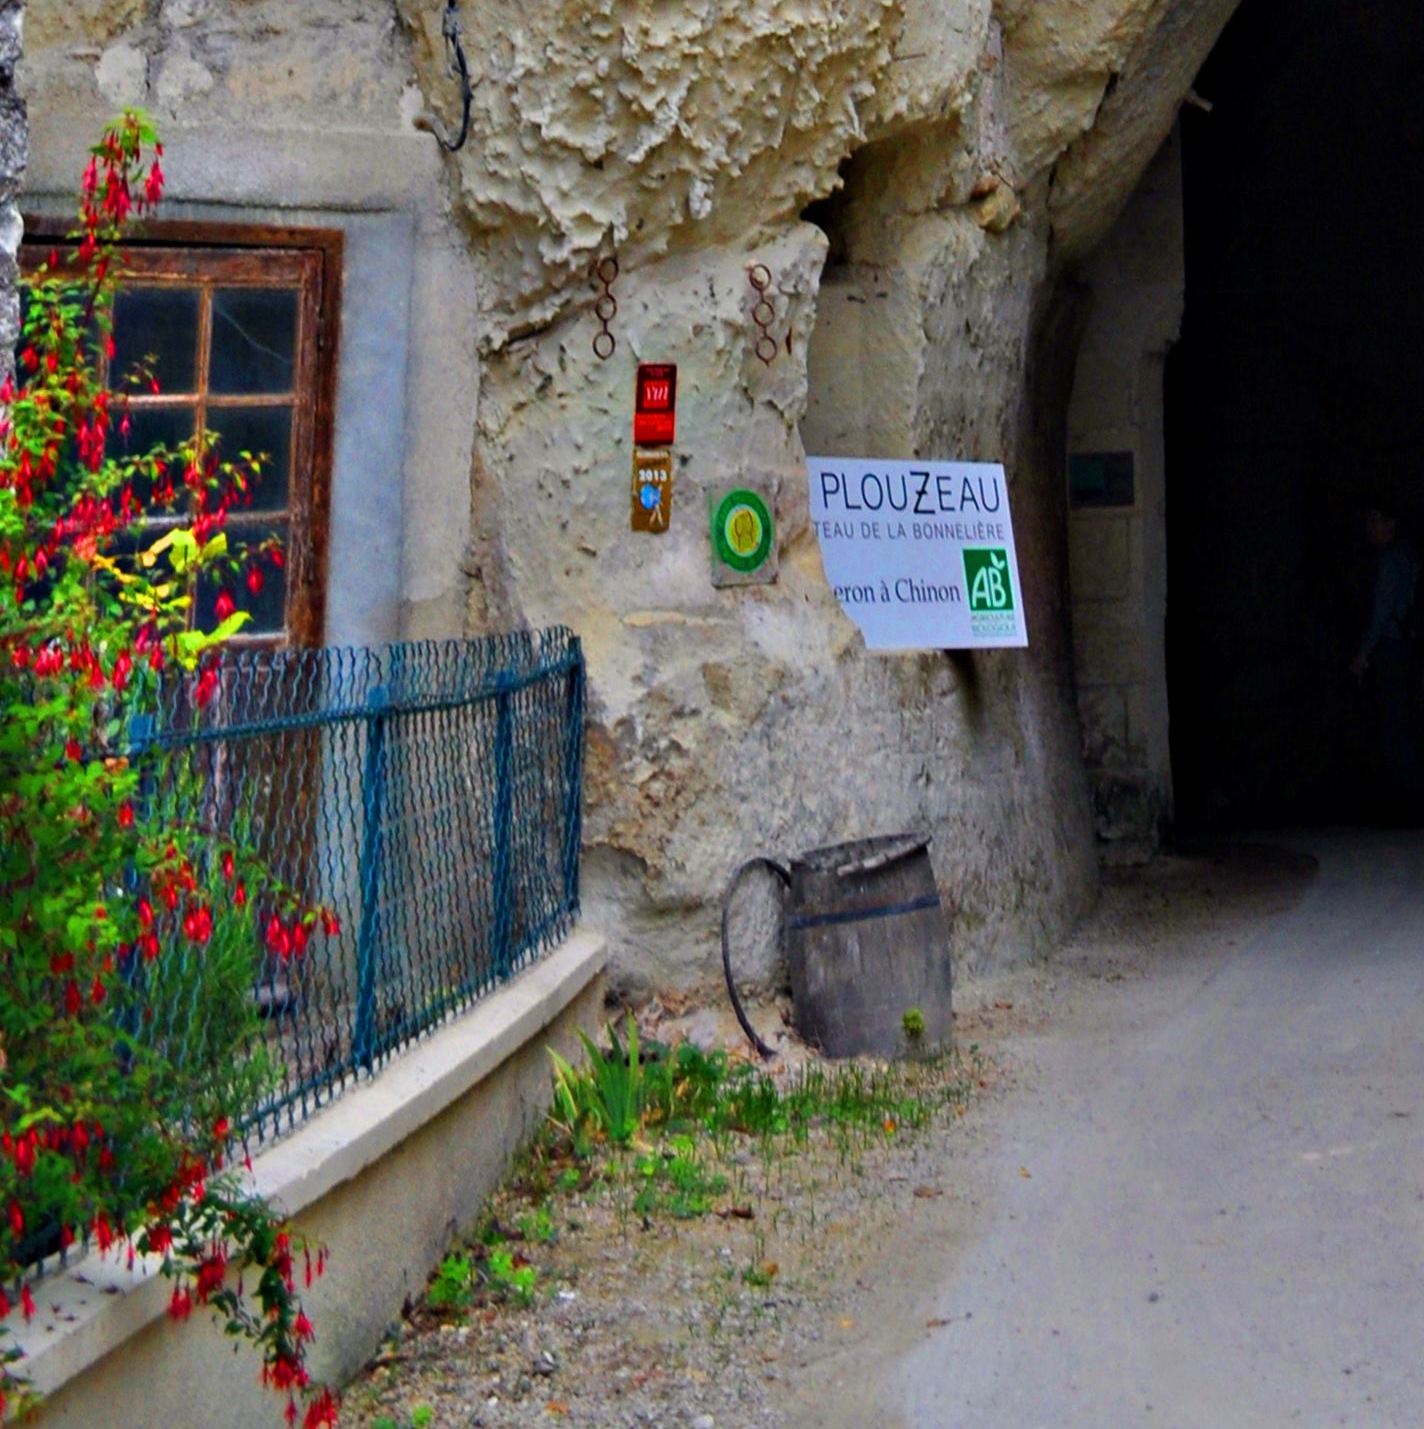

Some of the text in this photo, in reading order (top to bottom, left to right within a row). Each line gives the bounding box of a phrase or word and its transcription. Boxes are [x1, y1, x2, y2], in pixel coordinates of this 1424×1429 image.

[820, 470, 1001, 515] PLOUZEAU
[861, 521, 881, 539] DE
[887, 522, 908, 539] LA
[913, 519, 1005, 540] BONNELIÈRE
[880, 581, 891, 603] à
[895, 577, 961, 603] Chinon
[971, 566, 1008, 609] AB
